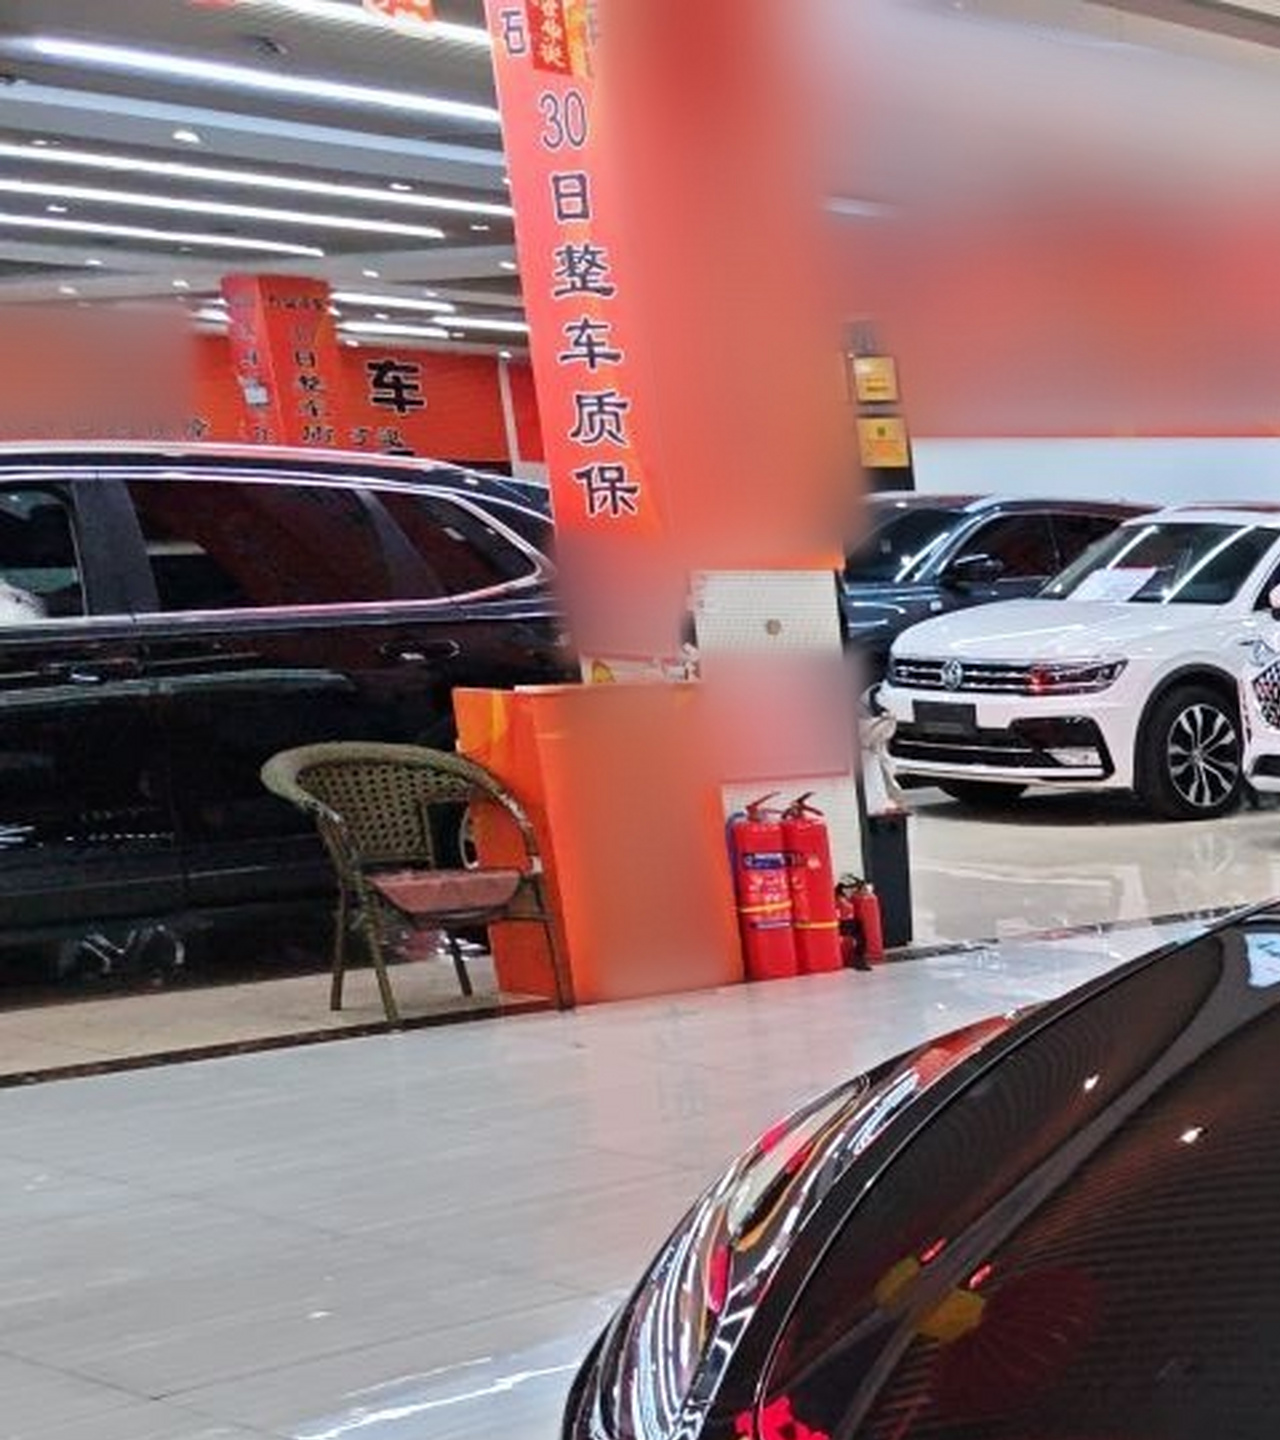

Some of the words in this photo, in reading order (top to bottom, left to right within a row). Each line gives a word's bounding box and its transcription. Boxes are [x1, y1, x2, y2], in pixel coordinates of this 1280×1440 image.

[366, 360, 425, 414] 车
[538, 90, 639, 517] 30日整车质保
